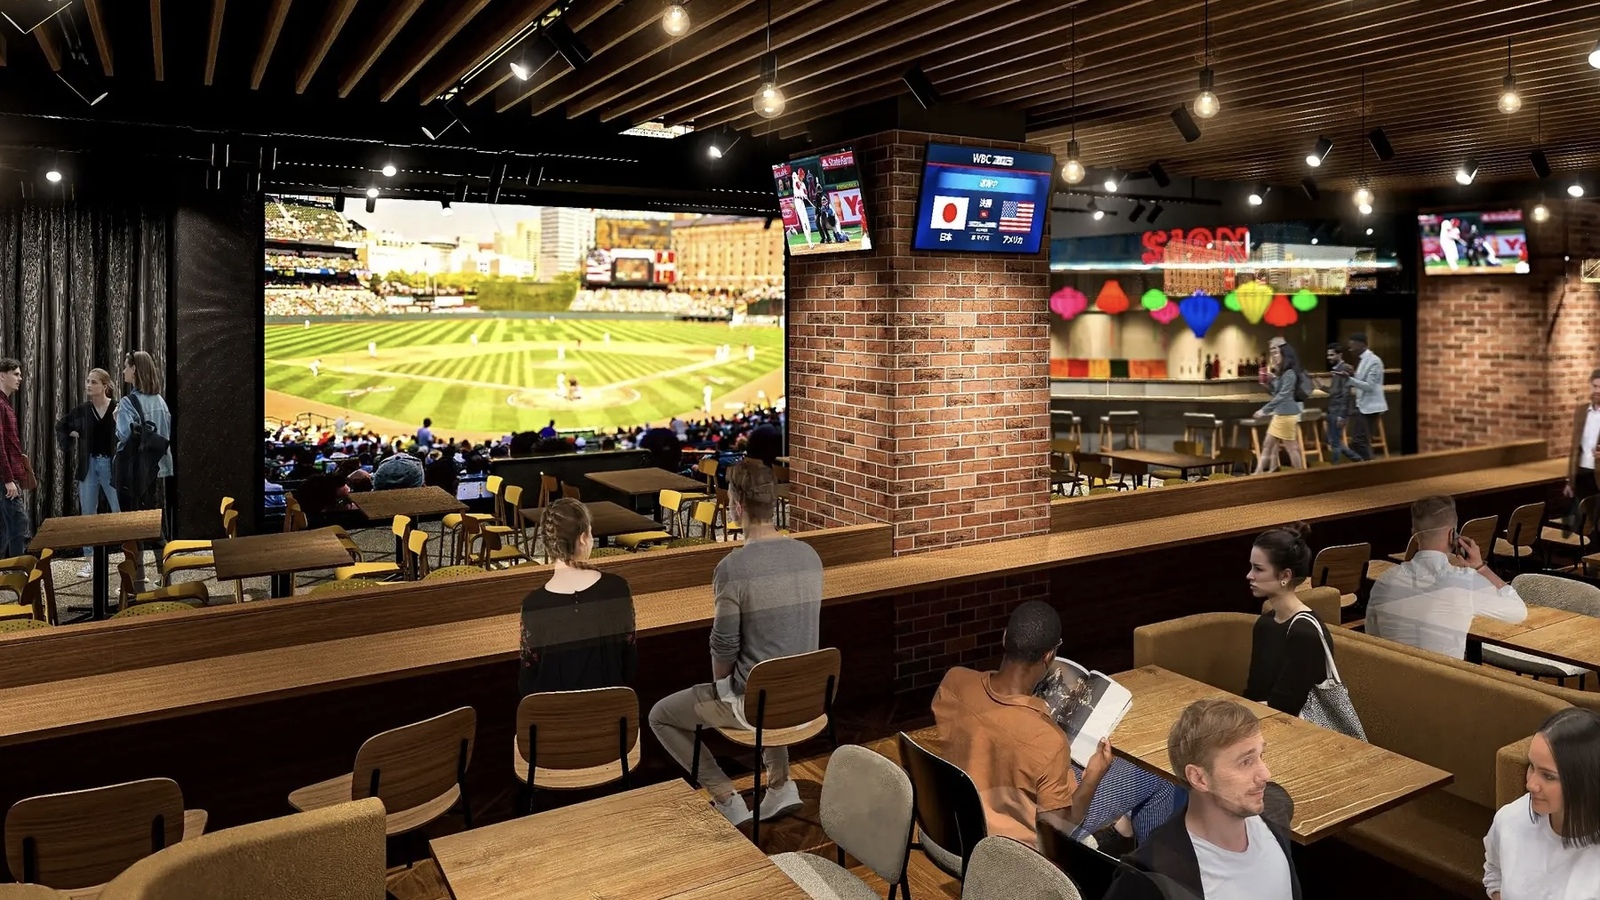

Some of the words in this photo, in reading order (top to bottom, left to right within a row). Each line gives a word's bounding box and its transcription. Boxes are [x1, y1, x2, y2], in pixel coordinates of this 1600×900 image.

[973, 153, 992, 164] WBC
[940, 232, 952, 242] 日本
[1003, 235, 1023, 244] アメリカ
